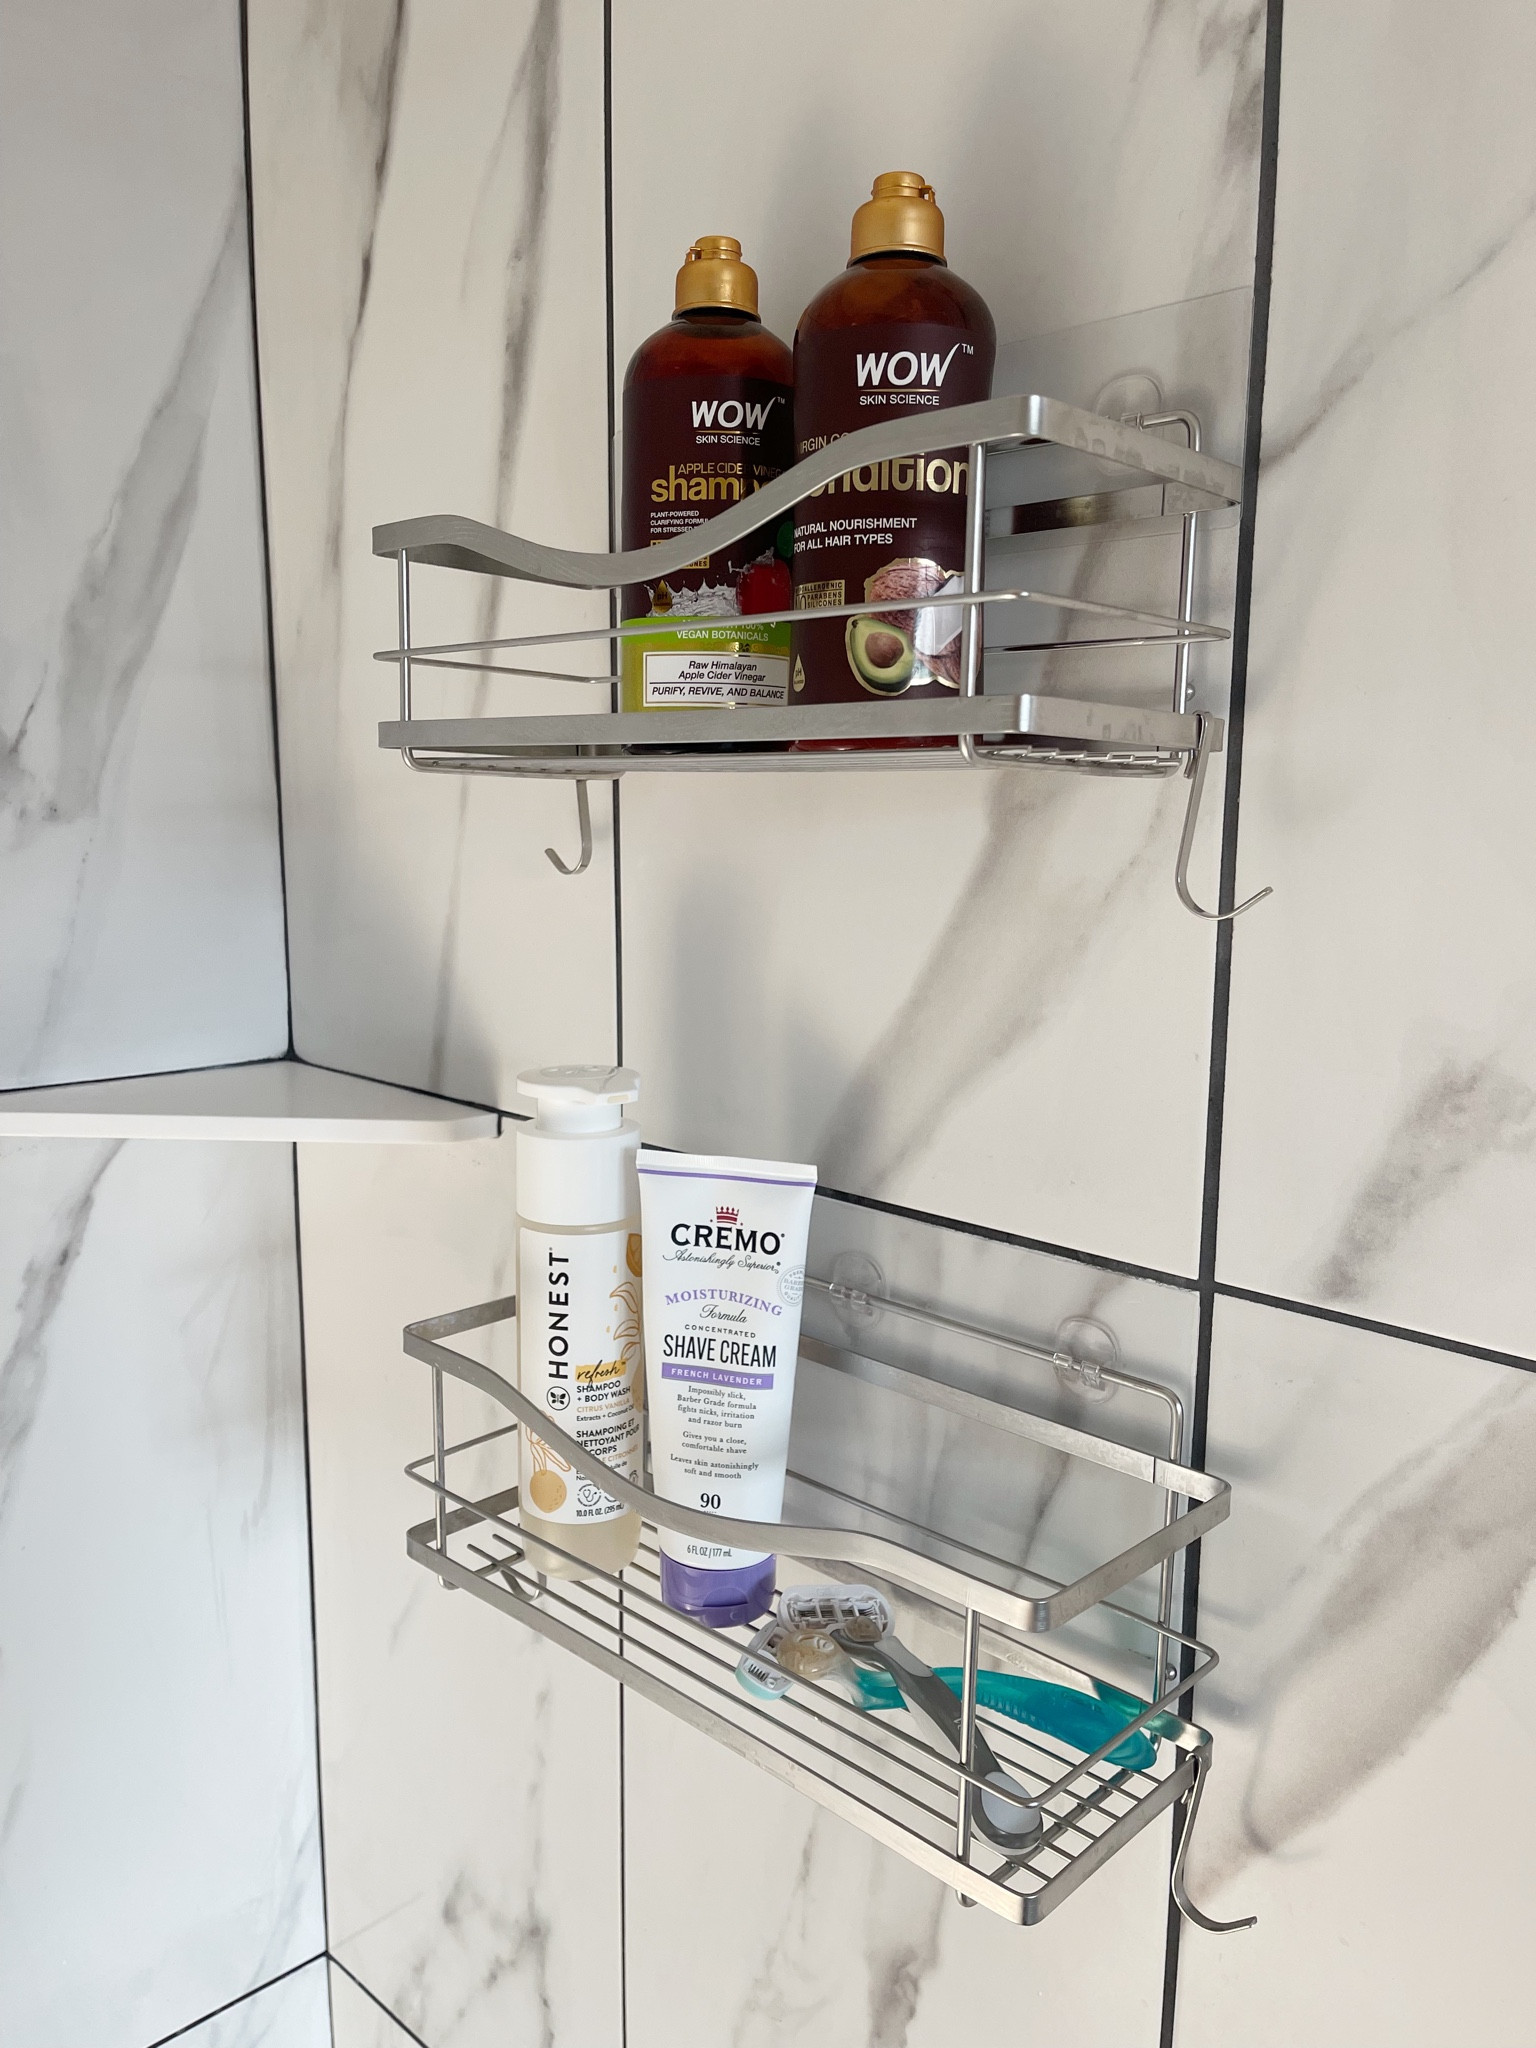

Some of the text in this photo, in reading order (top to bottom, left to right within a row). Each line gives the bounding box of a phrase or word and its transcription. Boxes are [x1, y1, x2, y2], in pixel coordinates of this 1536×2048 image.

[856, 343, 960, 387] WOW
[859, 394, 940, 406] SKIN SCIENCE
[691, 397, 776, 430] WOW
[695, 435, 760, 446] SKIN SCIENCE
[677, 463, 715, 475] APPLE
[716, 463, 743, 474] CIDE
[650, 510, 699, 518] PLANT-POWERED
[794, 517, 917, 538] NATURAL NOURISHMENT
[806, 541, 823, 550] ALL
[825, 536, 851, 547] HAIR
[854, 533, 893, 545] TYPES
[807, 591, 842, 601] PARABENS
[807, 599, 842, 609] SILICONES
[676, 630, 769, 642] VEGAN BOTANICALS
[689, 660, 757, 672] Raw Himalayan
[678, 670, 766, 683] Apple Cider Vinegar
[652, 686, 784, 699] PURIFY, REVIVE, AND BALANCE
[671, 1223, 781, 1255] CREMO
[662, 1249, 735, 1269] Astonishingly
[737, 1255, 779, 1274] Superior
[664, 1289, 783, 1316] MOISTURIZING
[548, 1252, 569, 1379] HONEST
[700, 1304, 747, 1323] Formula
[684, 1324, 756, 1338] CONCENTRATED
[663, 1334, 777, 1367] SHAVE CREAM
[577, 1360, 621, 1386] refresh
[671, 1368, 763, 1386] FRENCH LAVENDER
[576, 1380, 621, 1393] SHAMPOO
[585, 1393, 609, 1402] BODY
[611, 1386, 631, 1398] WASH
[688, 1386, 746, 1400] Impossibly slick,
[677, 1394, 757, 1410] Barber Grade formula
[677, 1404, 755, 1420] fights nicks, irritation
[576, 1422, 627, 1438] SHAMPOING
[703, 1419, 722, 1427] razor
[724, 1420, 743, 1428] burn
[682, 1430, 702, 1440] Gives
[704, 1435, 717, 1443] you
[726, 1436, 747, 1445] close,
[681, 1441, 747, 1454] comfortable shave
[670, 1453, 759, 1471] Leaves skin astonishingly
[684, 1466, 742, 1479] soft and smooth
[700, 1492, 721, 1510] 90
[686, 1544, 692, 1554] 6
[692, 1545, 699, 1556] FL
